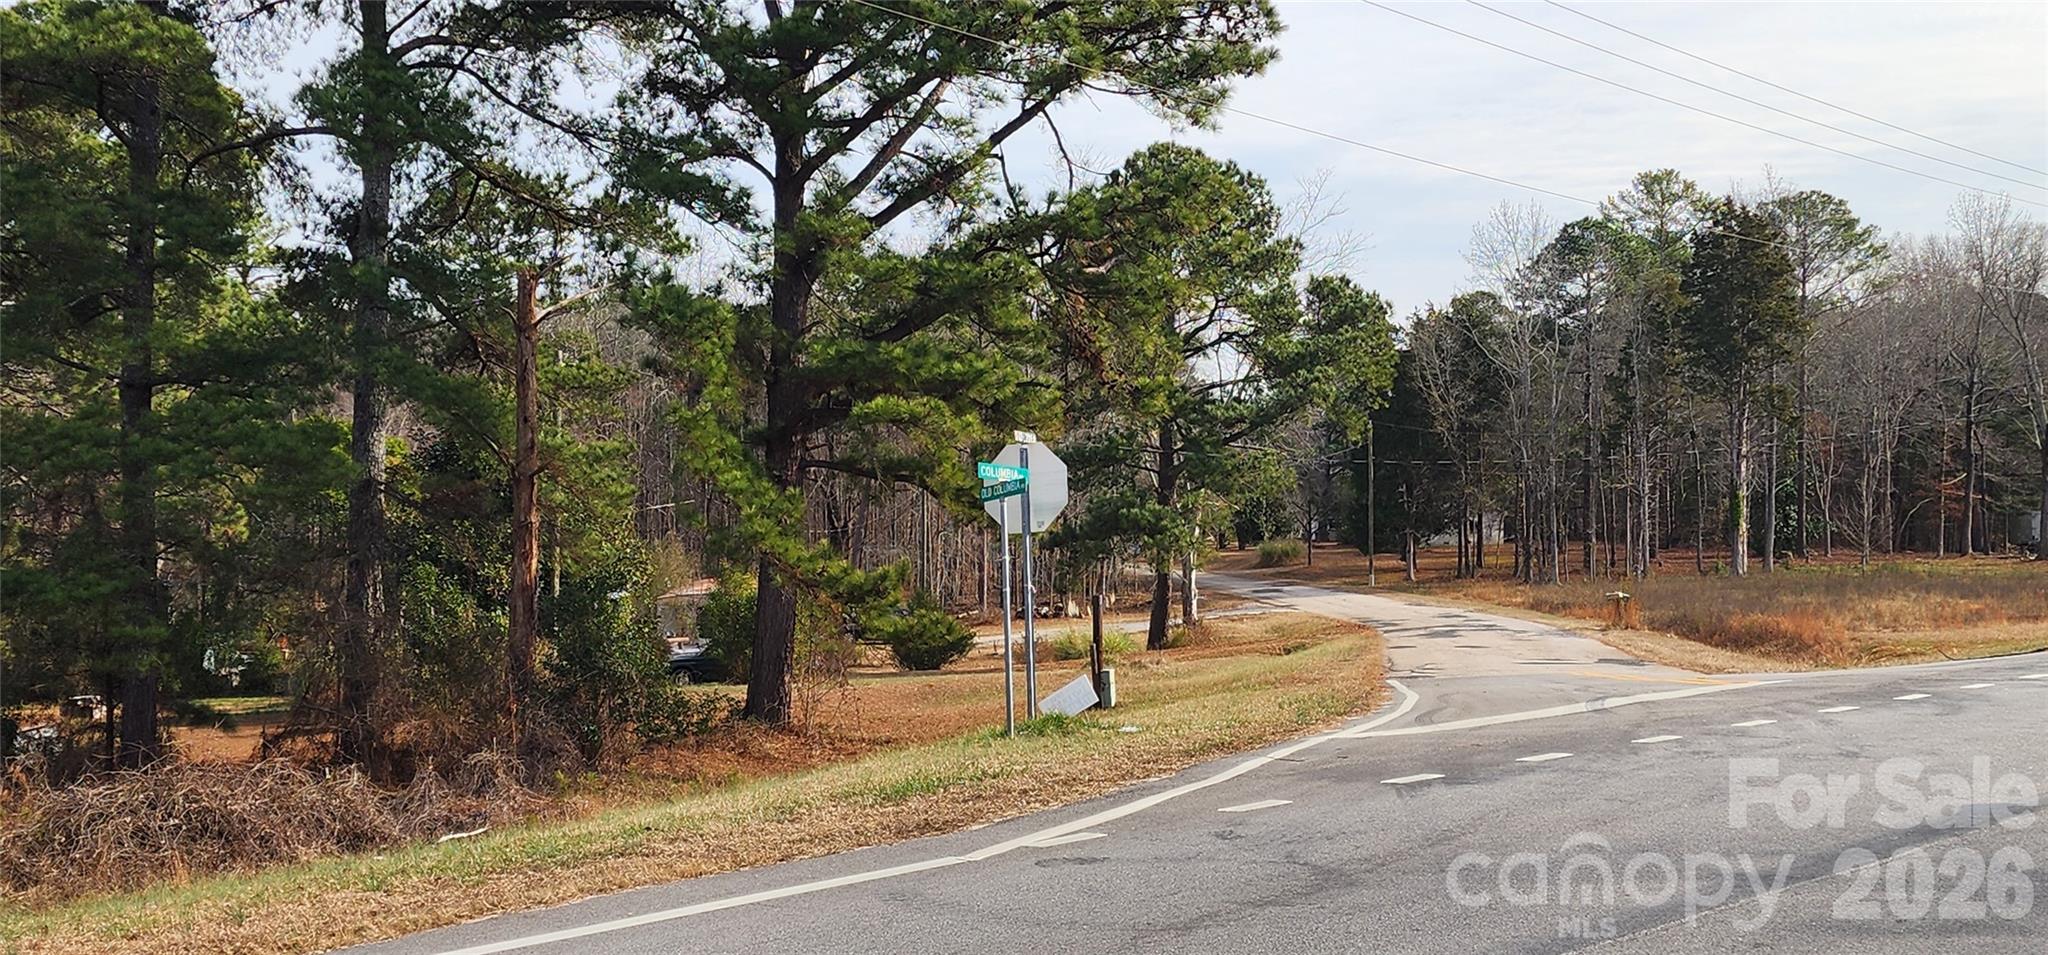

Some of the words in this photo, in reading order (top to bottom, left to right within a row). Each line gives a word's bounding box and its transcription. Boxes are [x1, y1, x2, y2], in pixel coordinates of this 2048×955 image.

[981, 465, 1018, 479] COLUMBIA
[981, 488, 992, 499] OLD
[993, 481, 1020, 496] COLUMBIA
